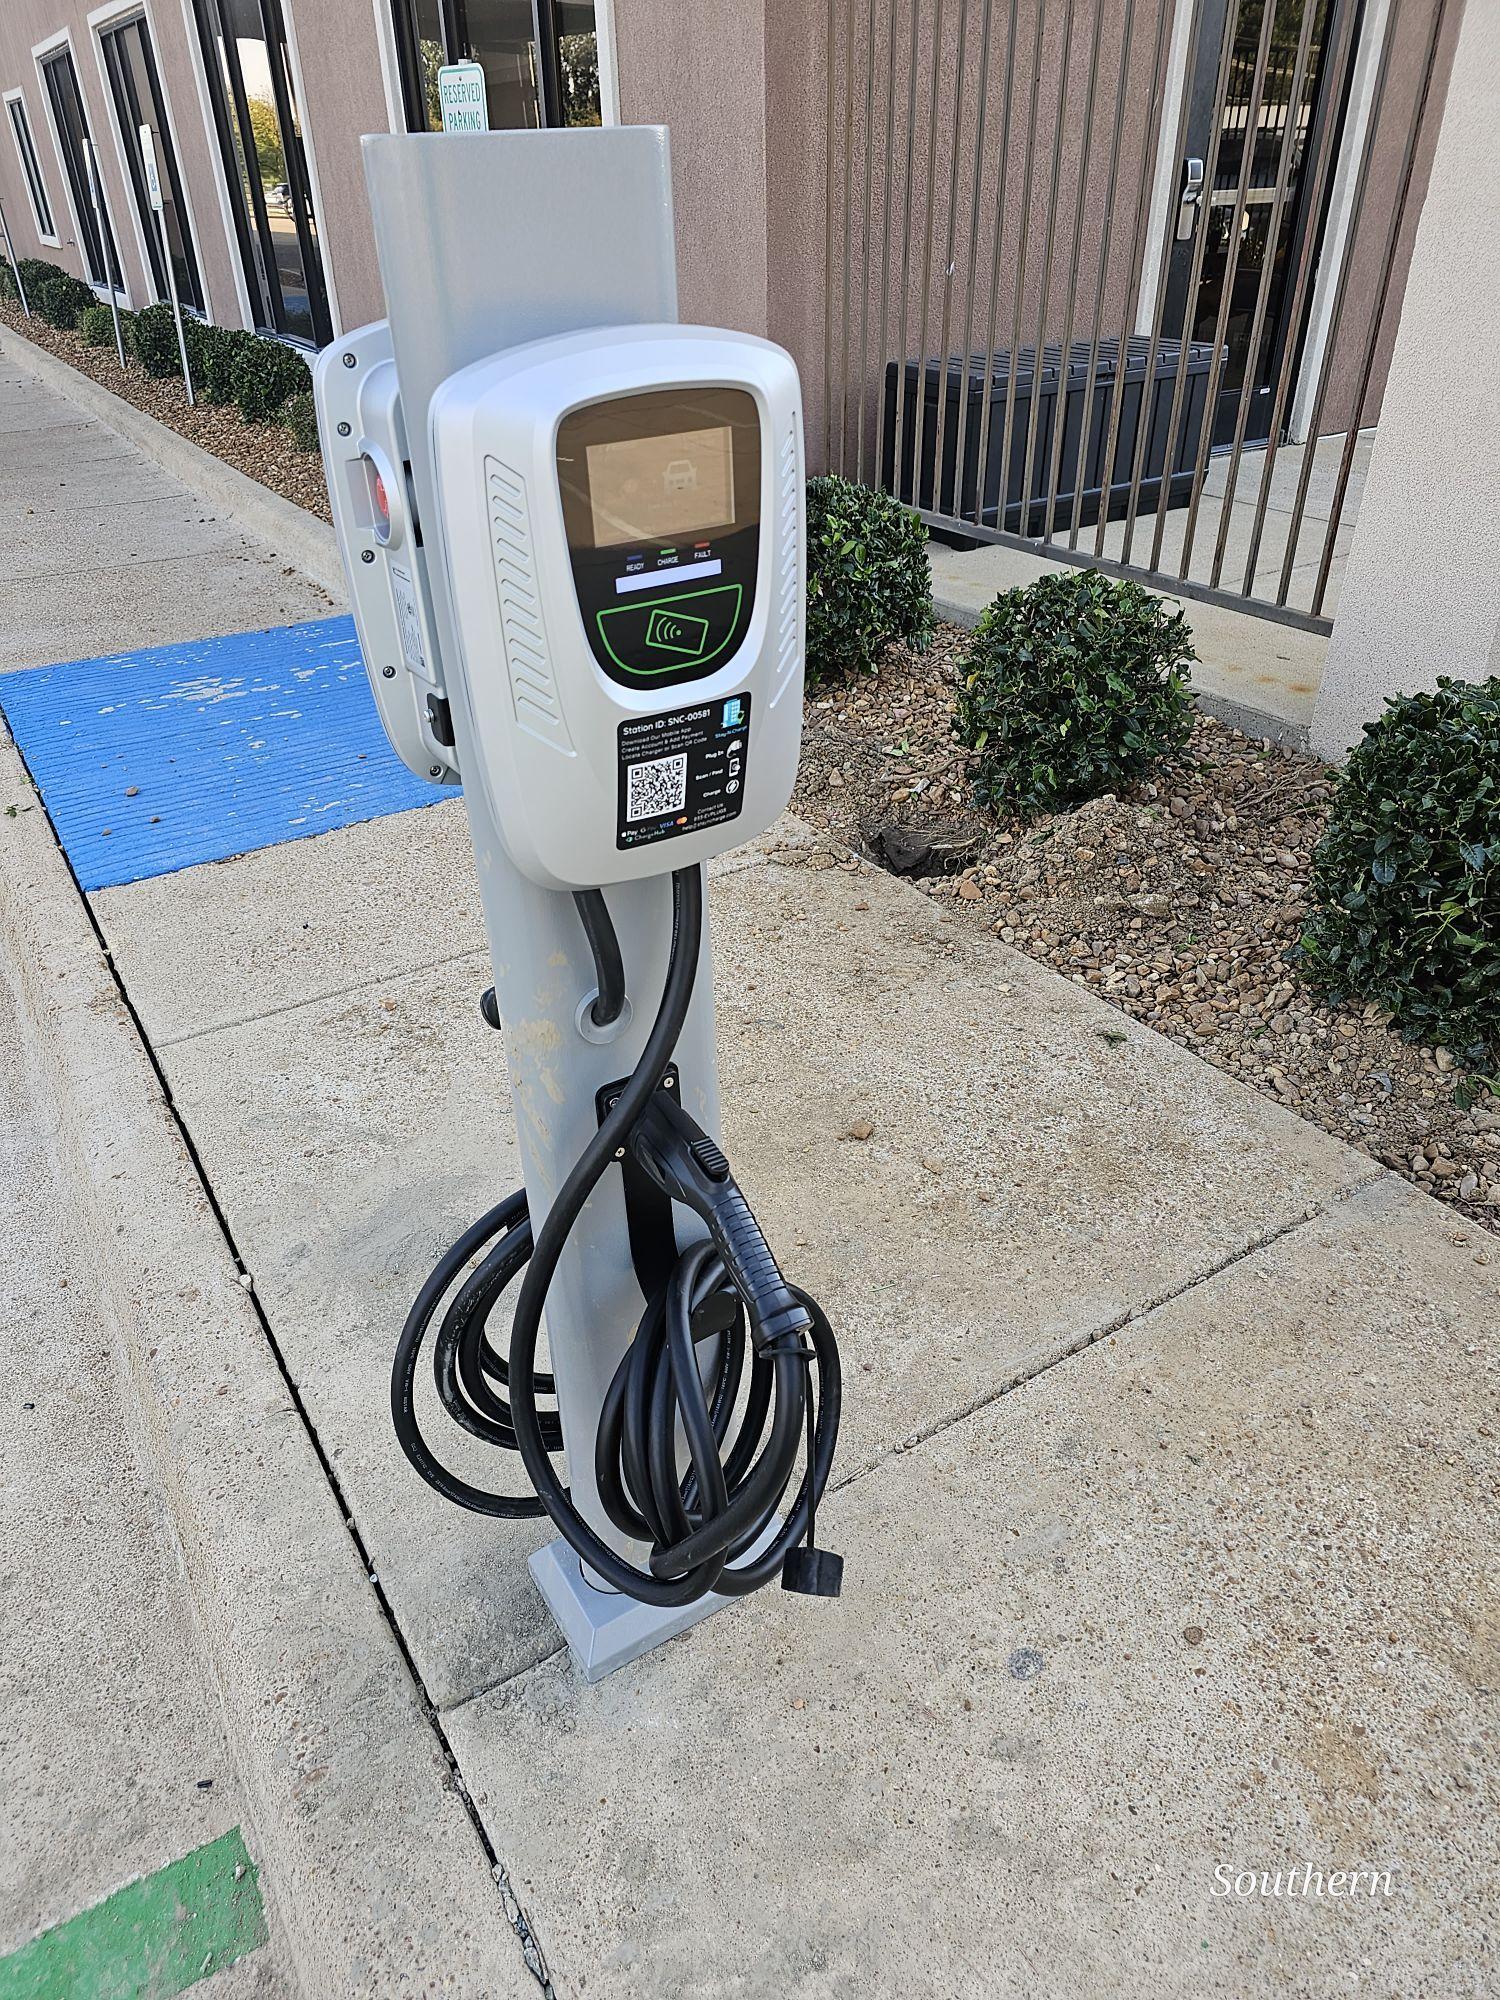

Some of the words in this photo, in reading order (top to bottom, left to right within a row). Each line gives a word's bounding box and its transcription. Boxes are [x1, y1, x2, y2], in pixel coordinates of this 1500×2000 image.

[443, 82, 481, 104] RESERVED
[448, 111, 481, 130] PARKING
[694, 549, 712, 559] FAULT
[626, 562, 644, 572] READY
[657, 556, 679, 566] CHARGE
[623, 723, 654, 736] Station
[655, 719, 667, 729] ID:
[667, 708, 711, 726] SNC-00581
[621, 736, 650, 746] Download
[661, 730, 680, 738] Mobile
[621, 745, 640, 753] Create
[641, 741, 664, 749] Account
[681, 730, 704, 740] Payment
[621, 752, 641, 760] Locate
[641, 747, 664, 757] Charger
[702, 789, 721, 798] Charge
[659, 821, 674, 829] VISA
